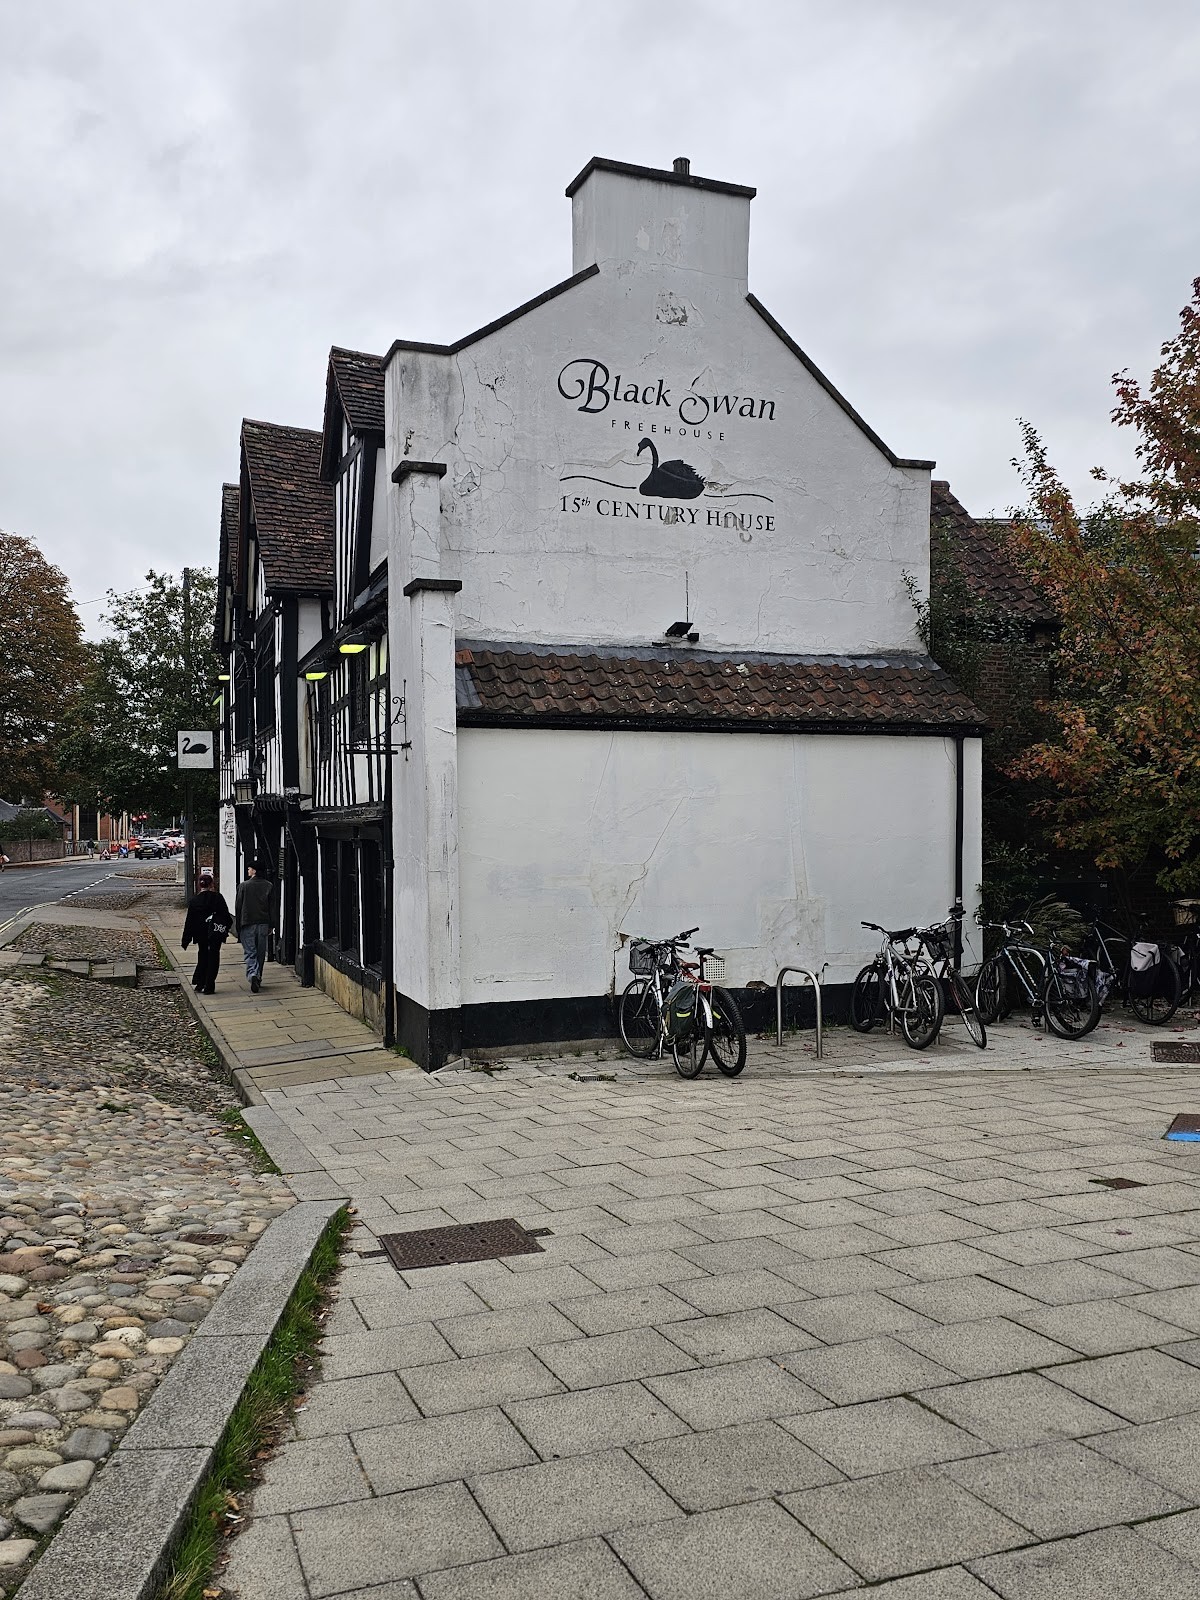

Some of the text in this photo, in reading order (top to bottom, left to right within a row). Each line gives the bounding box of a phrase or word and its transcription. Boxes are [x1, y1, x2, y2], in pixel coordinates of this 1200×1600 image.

[557, 358, 776, 426] Black Swan
[611, 419, 725, 441] FREEHOUSE
[596, 498, 699, 525] CENTURY
[706, 509, 776, 532] HOUSE
